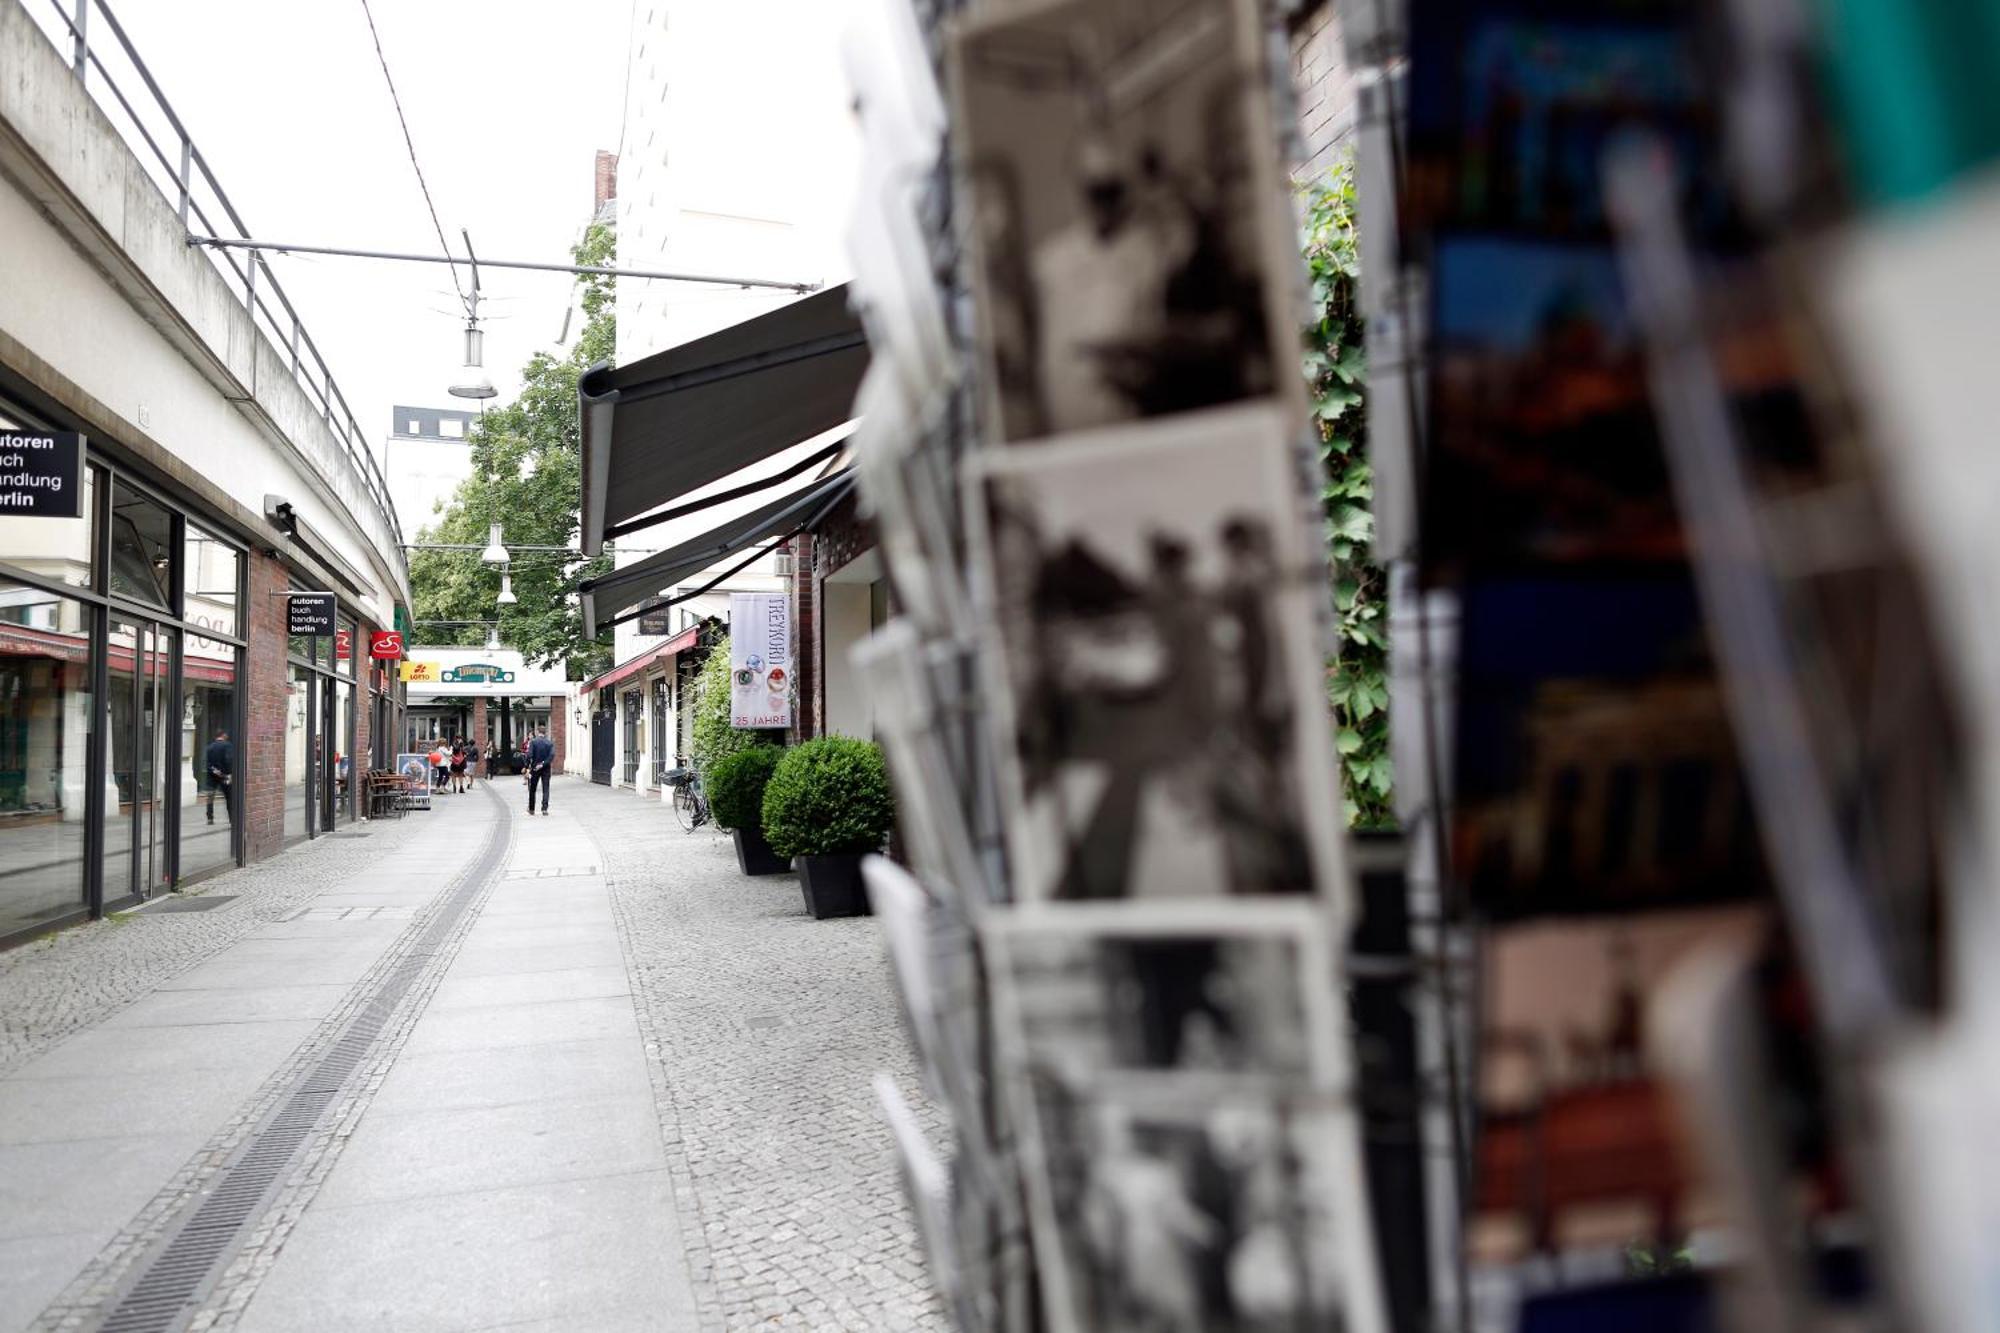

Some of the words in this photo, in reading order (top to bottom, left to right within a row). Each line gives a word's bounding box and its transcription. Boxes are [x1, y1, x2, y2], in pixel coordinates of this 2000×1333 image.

[0, 453, 23, 467] ch
[0, 472, 62, 491] ndlung
[291, 606, 312, 614] buch
[291, 615, 328, 625] handlung
[291, 624, 316, 633] berlin
[736, 716, 749, 726] 25
[751, 715, 786, 726] JAHRE
